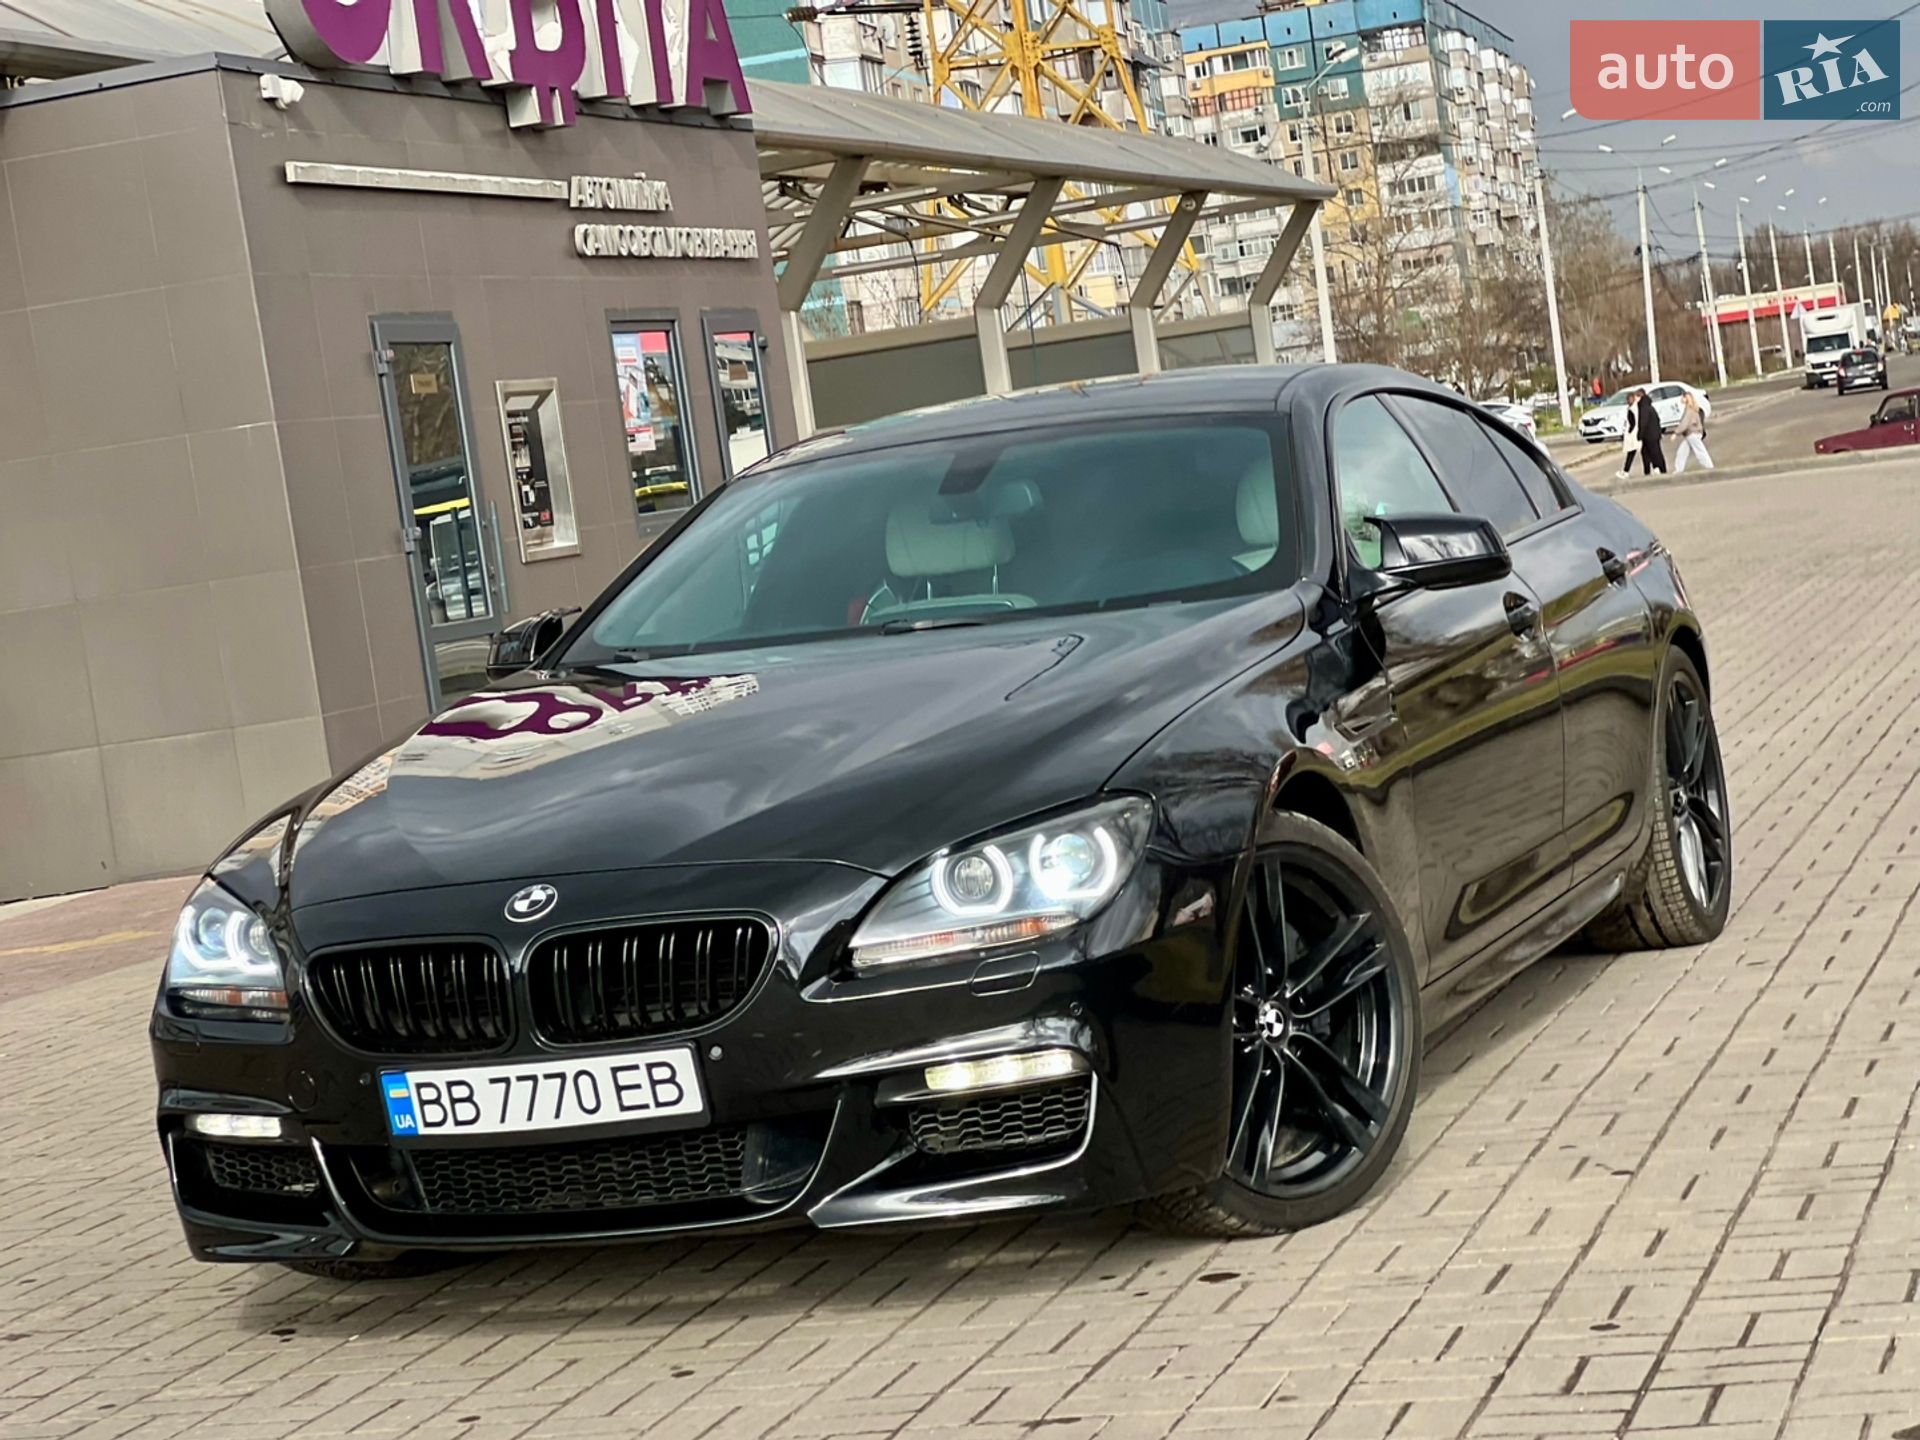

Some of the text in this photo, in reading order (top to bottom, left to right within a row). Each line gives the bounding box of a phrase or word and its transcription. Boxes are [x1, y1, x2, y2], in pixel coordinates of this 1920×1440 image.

[414, 1061, 684, 1128] BB 7770 EB
[395, 1113, 416, 1129] UA
